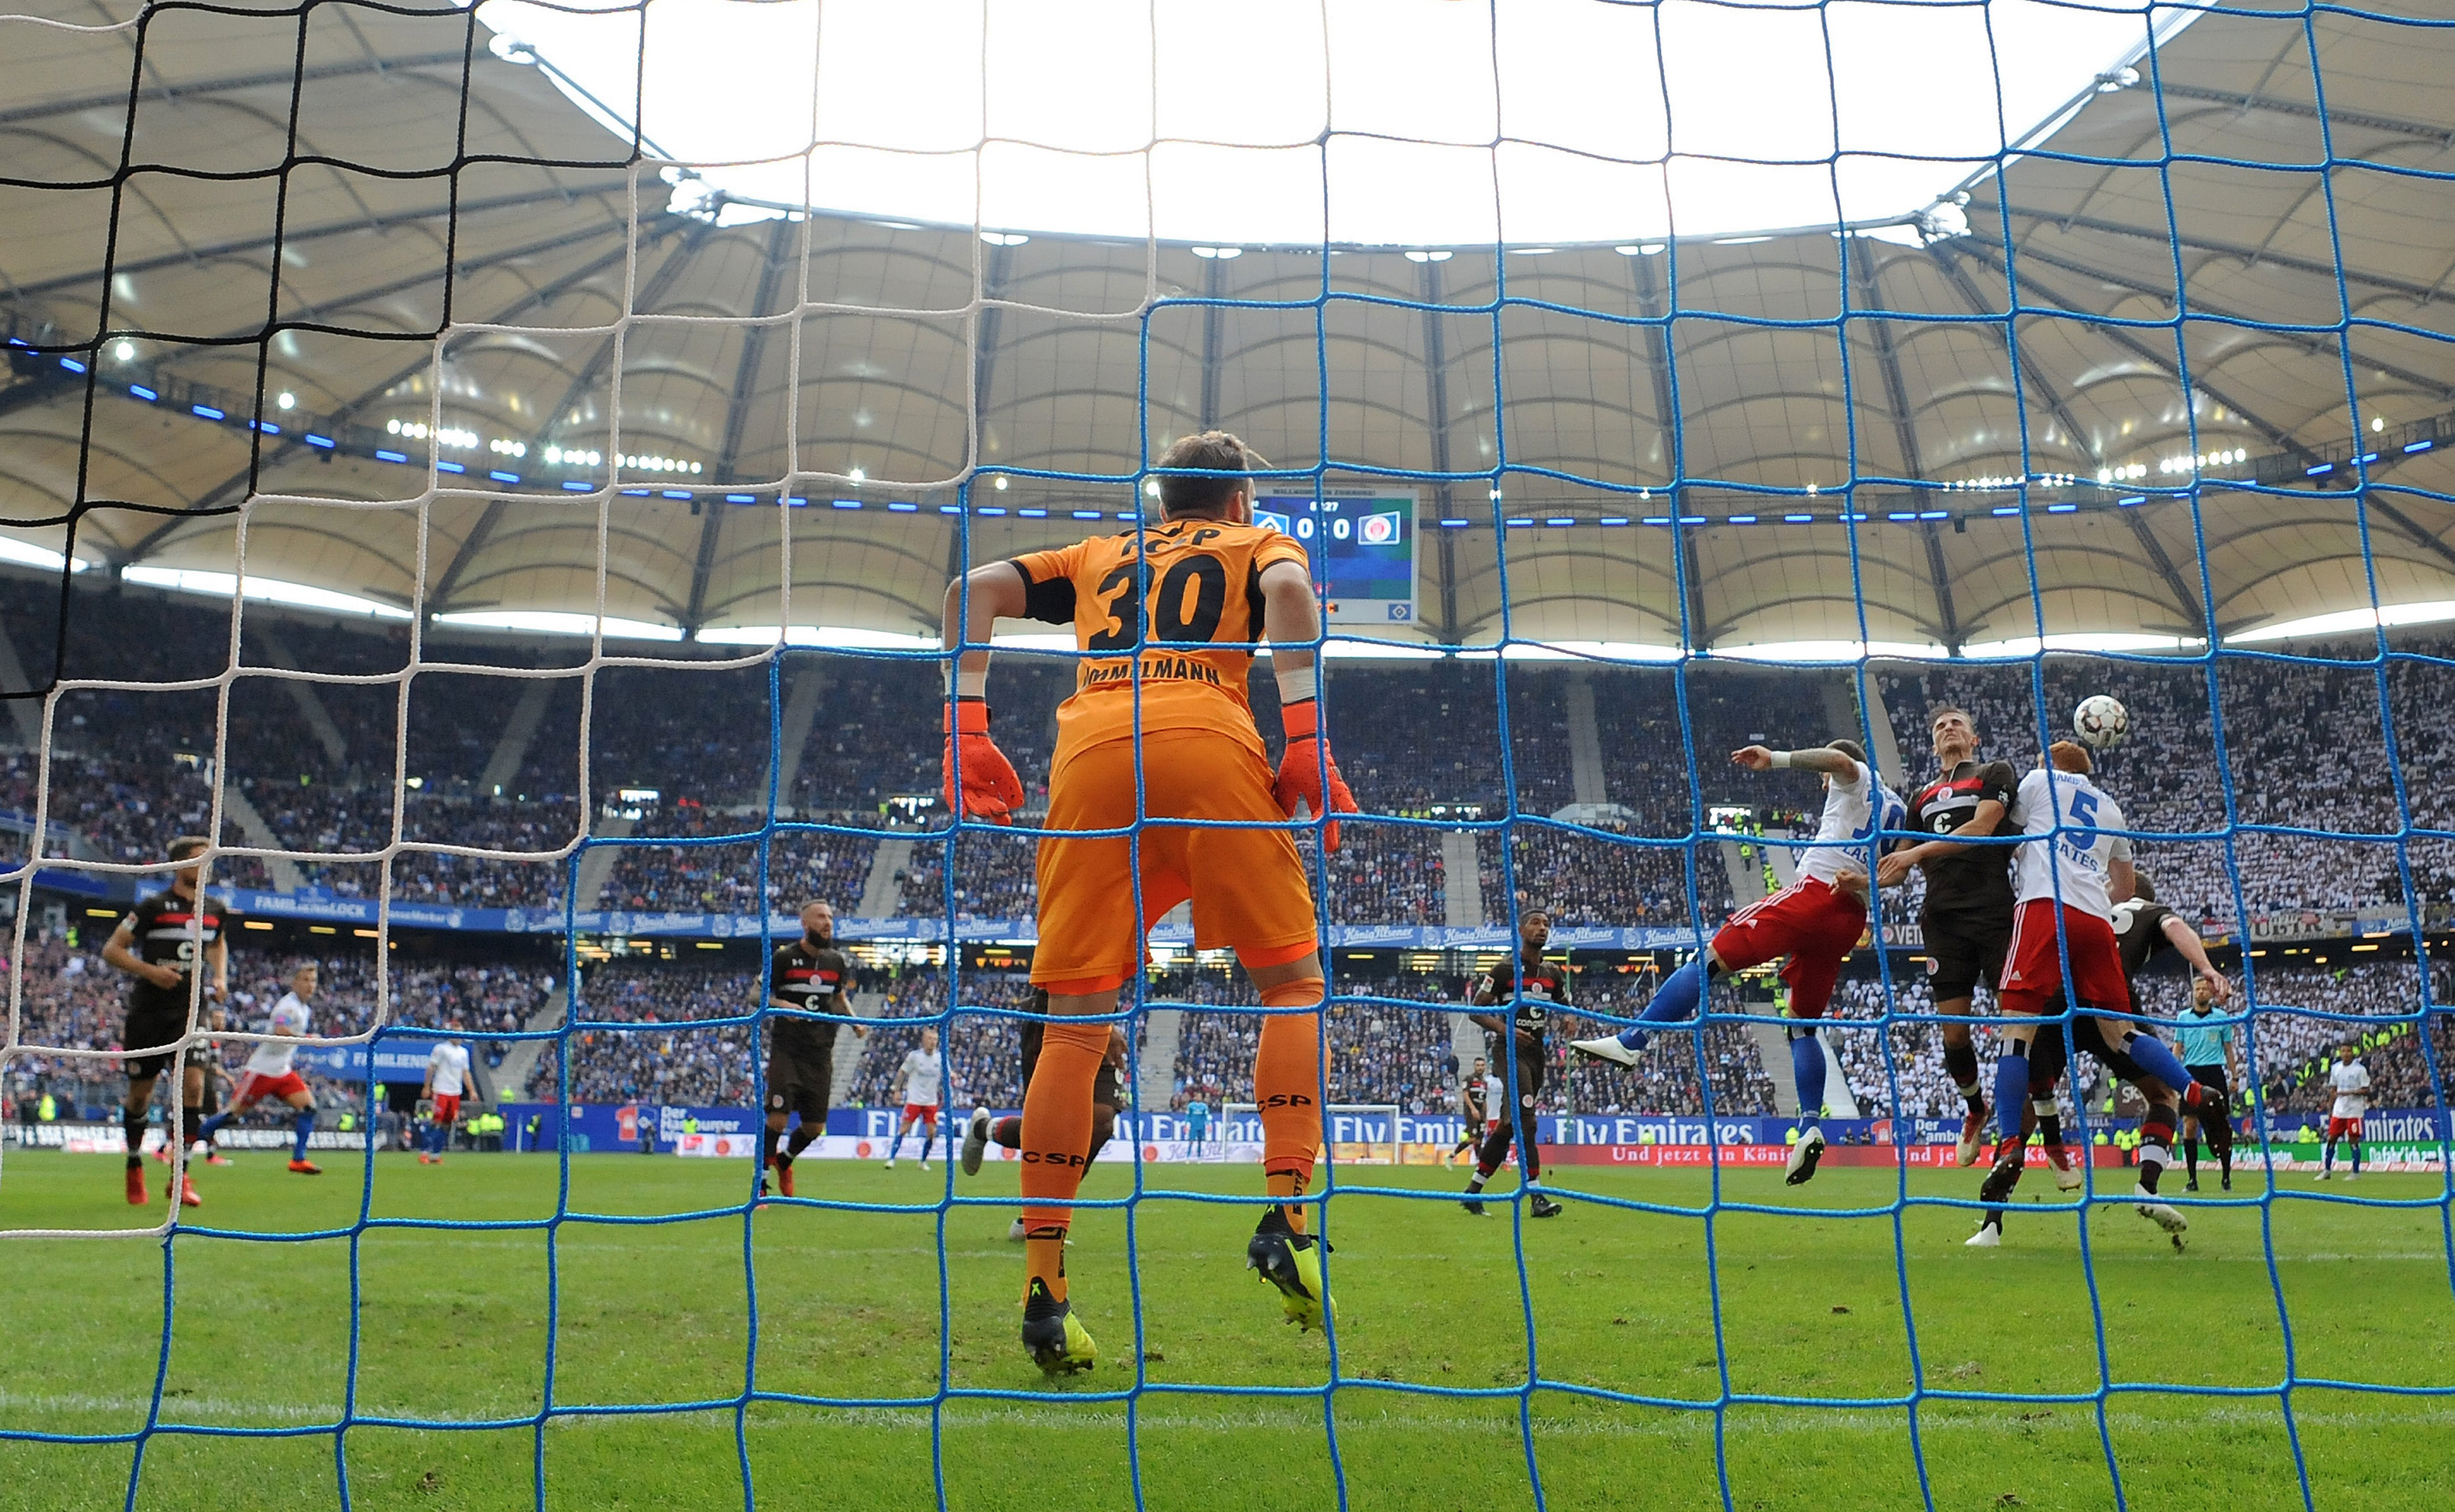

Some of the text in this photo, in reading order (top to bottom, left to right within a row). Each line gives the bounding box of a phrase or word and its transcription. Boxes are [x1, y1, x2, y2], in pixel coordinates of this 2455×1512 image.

[1297, 518, 1314, 538] 0
[1333, 518, 1350, 539] 0
[1088, 554, 1227, 658] 30
[2065, 790, 2098, 850] 5
[1333, 1118, 1386, 1143] Fly
[1555, 1118, 1754, 1145] Fly Emirates
[1915, 1119, 1940, 1132] Der
[1612, 1146, 1650, 1161] Und
[1656, 1145, 1700, 1167] jetzt
